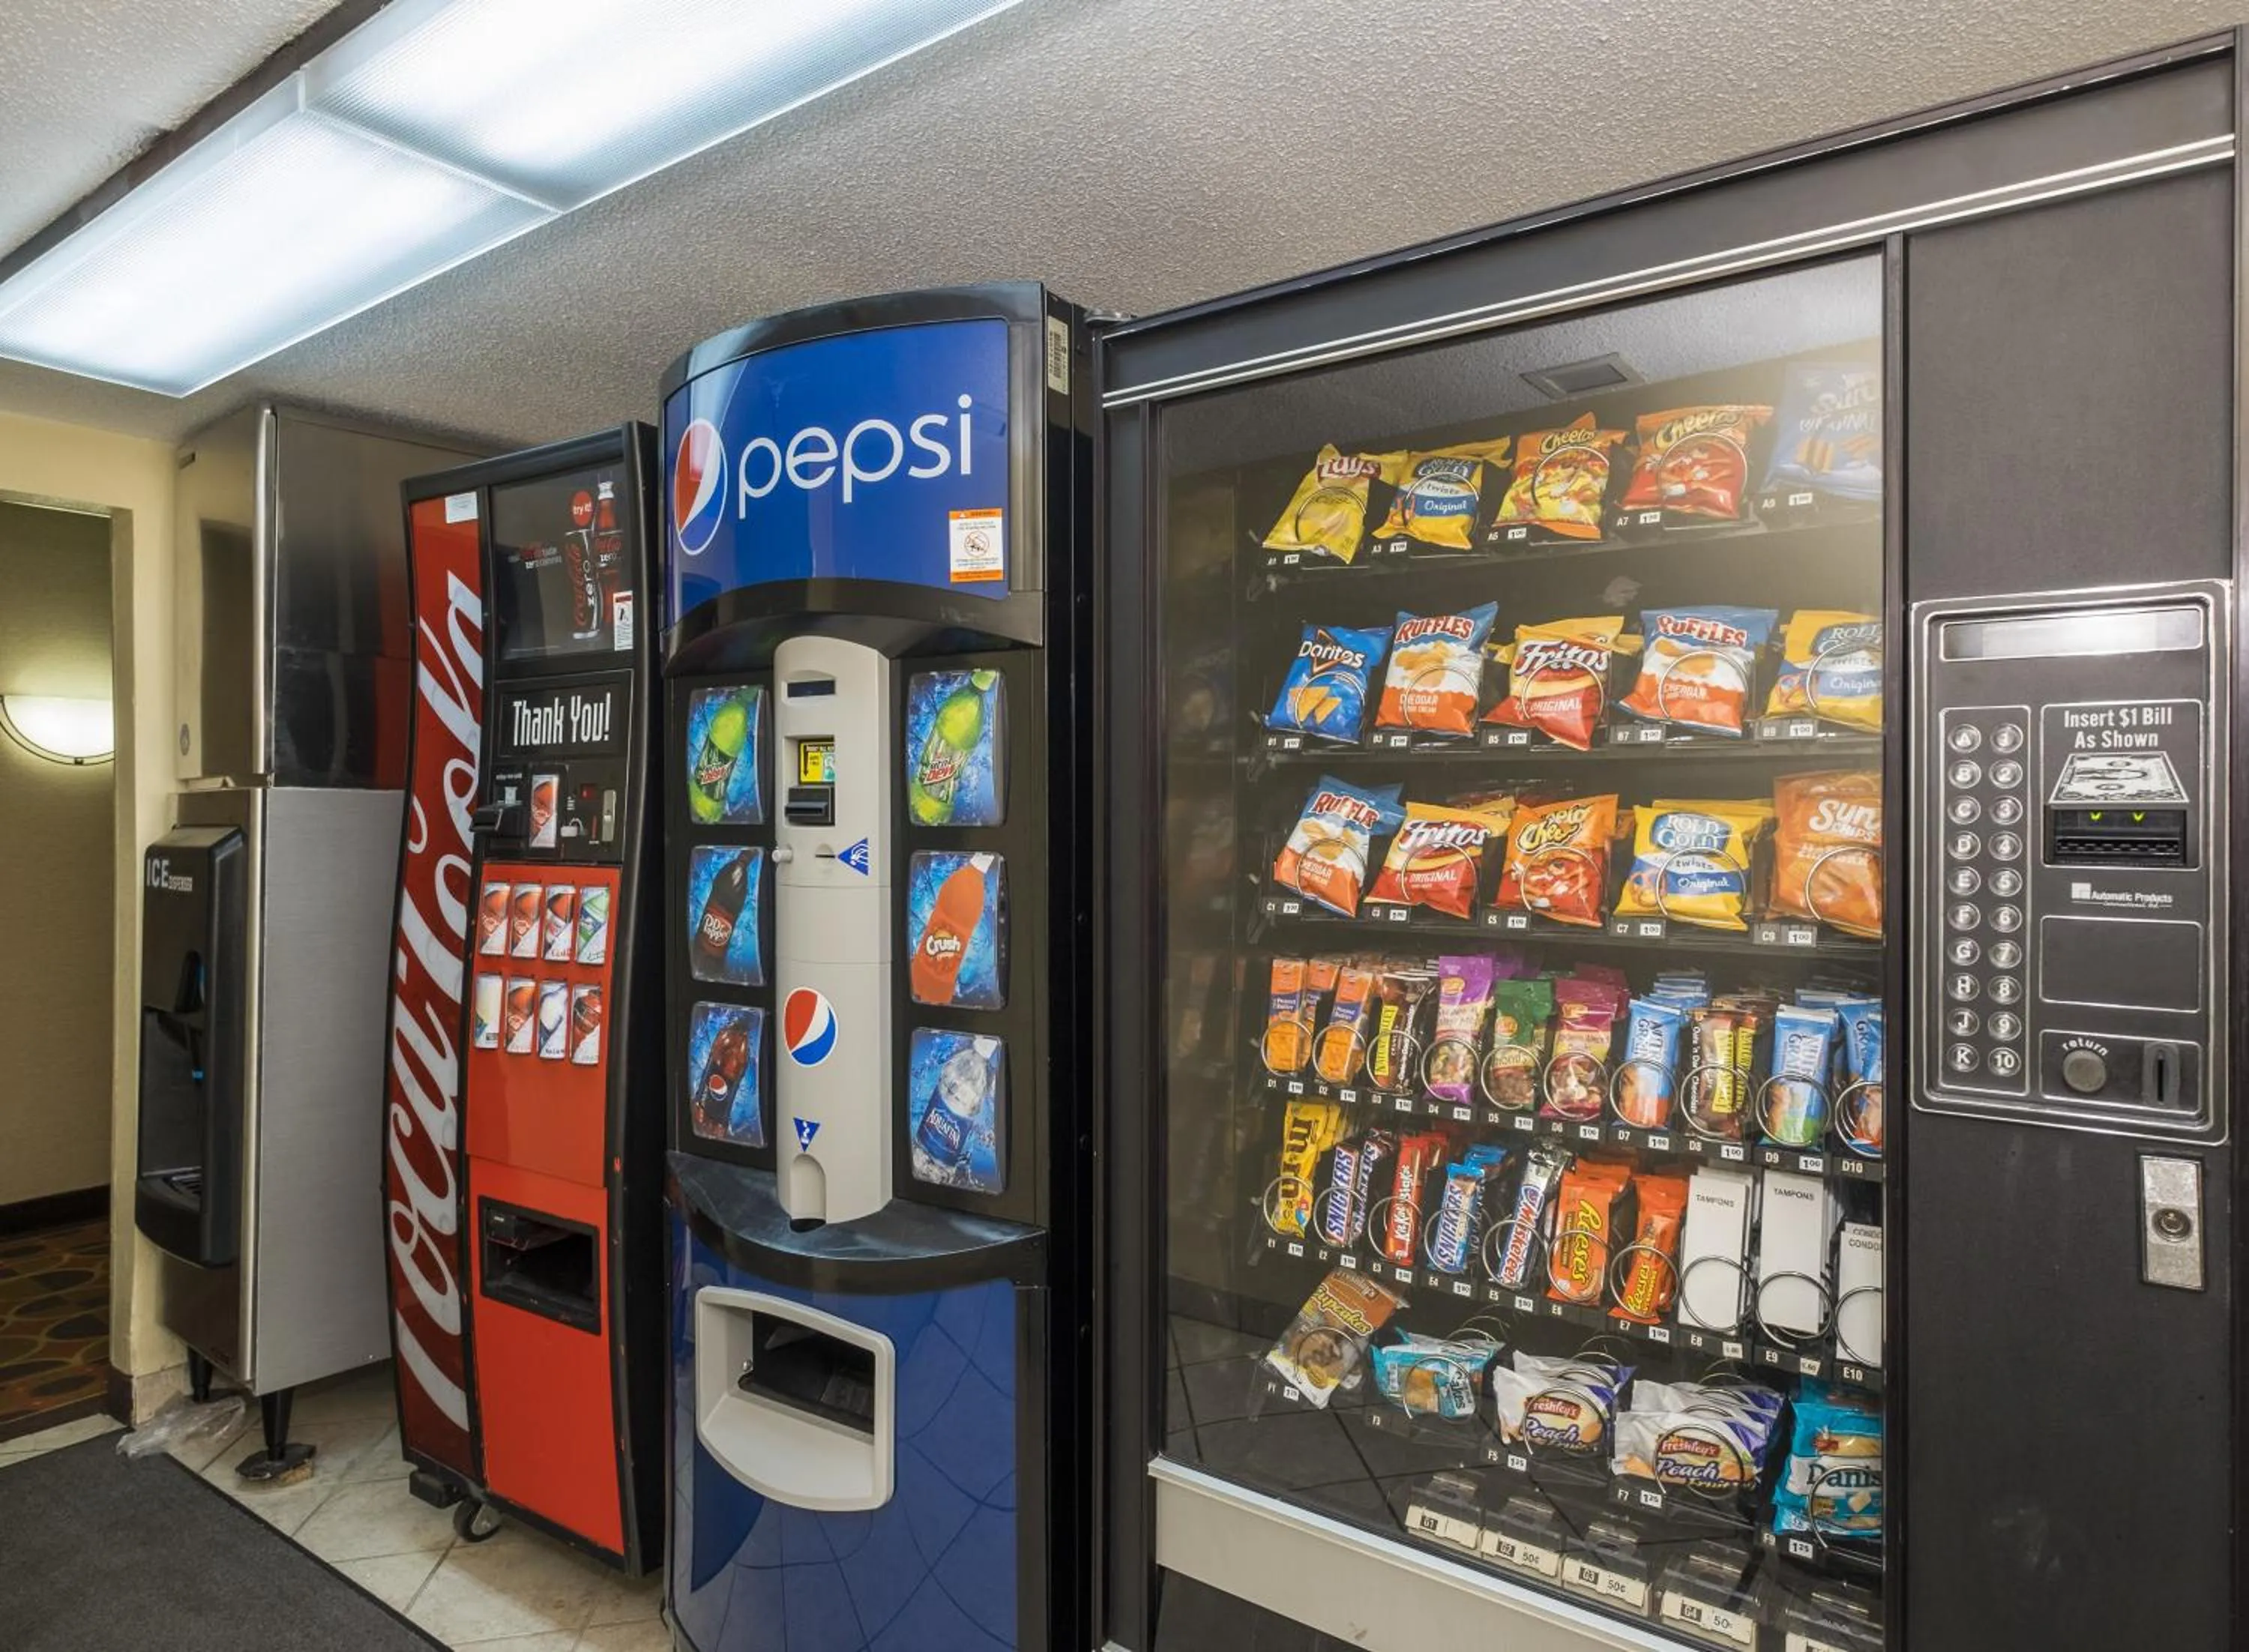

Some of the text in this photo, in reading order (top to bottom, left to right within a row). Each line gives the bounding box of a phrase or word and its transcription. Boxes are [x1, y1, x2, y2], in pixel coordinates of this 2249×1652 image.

[738, 394, 972, 519] pepsi
[1395, 615, 1475, 643] RUFFLES
[1656, 614, 1747, 647] RUFFLES
[1298, 640, 1366, 669] Doritos
[1514, 639, 1612, 675] Fritos
[513, 691, 612, 747] Thank You!
[2064, 707, 2173, 729] Insert $1 Bill
[2075, 730, 2159, 749] As Shown
[1398, 819, 1492, 851] Fritos
[146, 858, 169, 887] ICE
[925, 934, 960, 956] Crush
[2062, 1037, 2110, 1058] return
[1328, 1148, 1354, 1237] SNICKERS
[1696, 1193, 1735, 1208] TAMPONS
[1774, 1187, 1814, 1201] TAMPONS
[1436, 1184, 1463, 1265] SNICKERS
[1655, 1458, 1718, 1480] Peach
